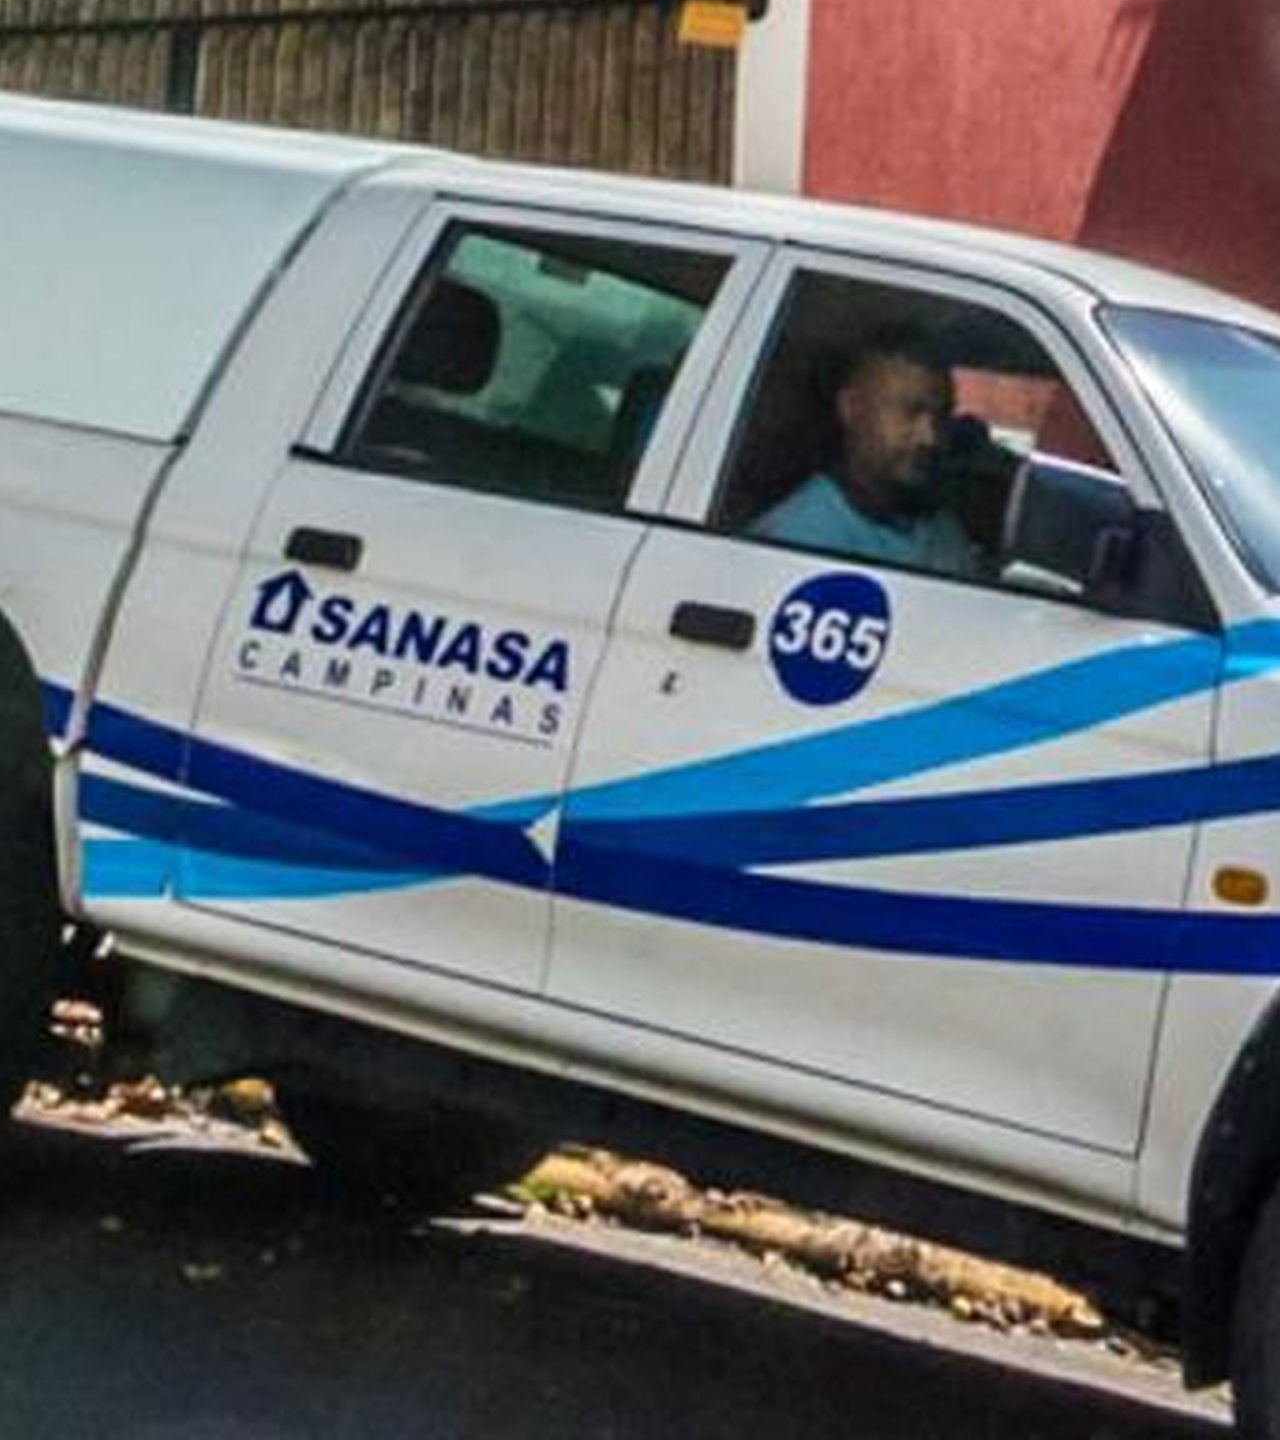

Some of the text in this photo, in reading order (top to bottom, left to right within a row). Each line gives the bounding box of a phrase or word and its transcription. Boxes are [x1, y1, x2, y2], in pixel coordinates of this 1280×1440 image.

[310, 594, 569, 692] SANASA
[775, 600, 886, 670] 365
[238, 640, 561, 735] CAMPINAS
